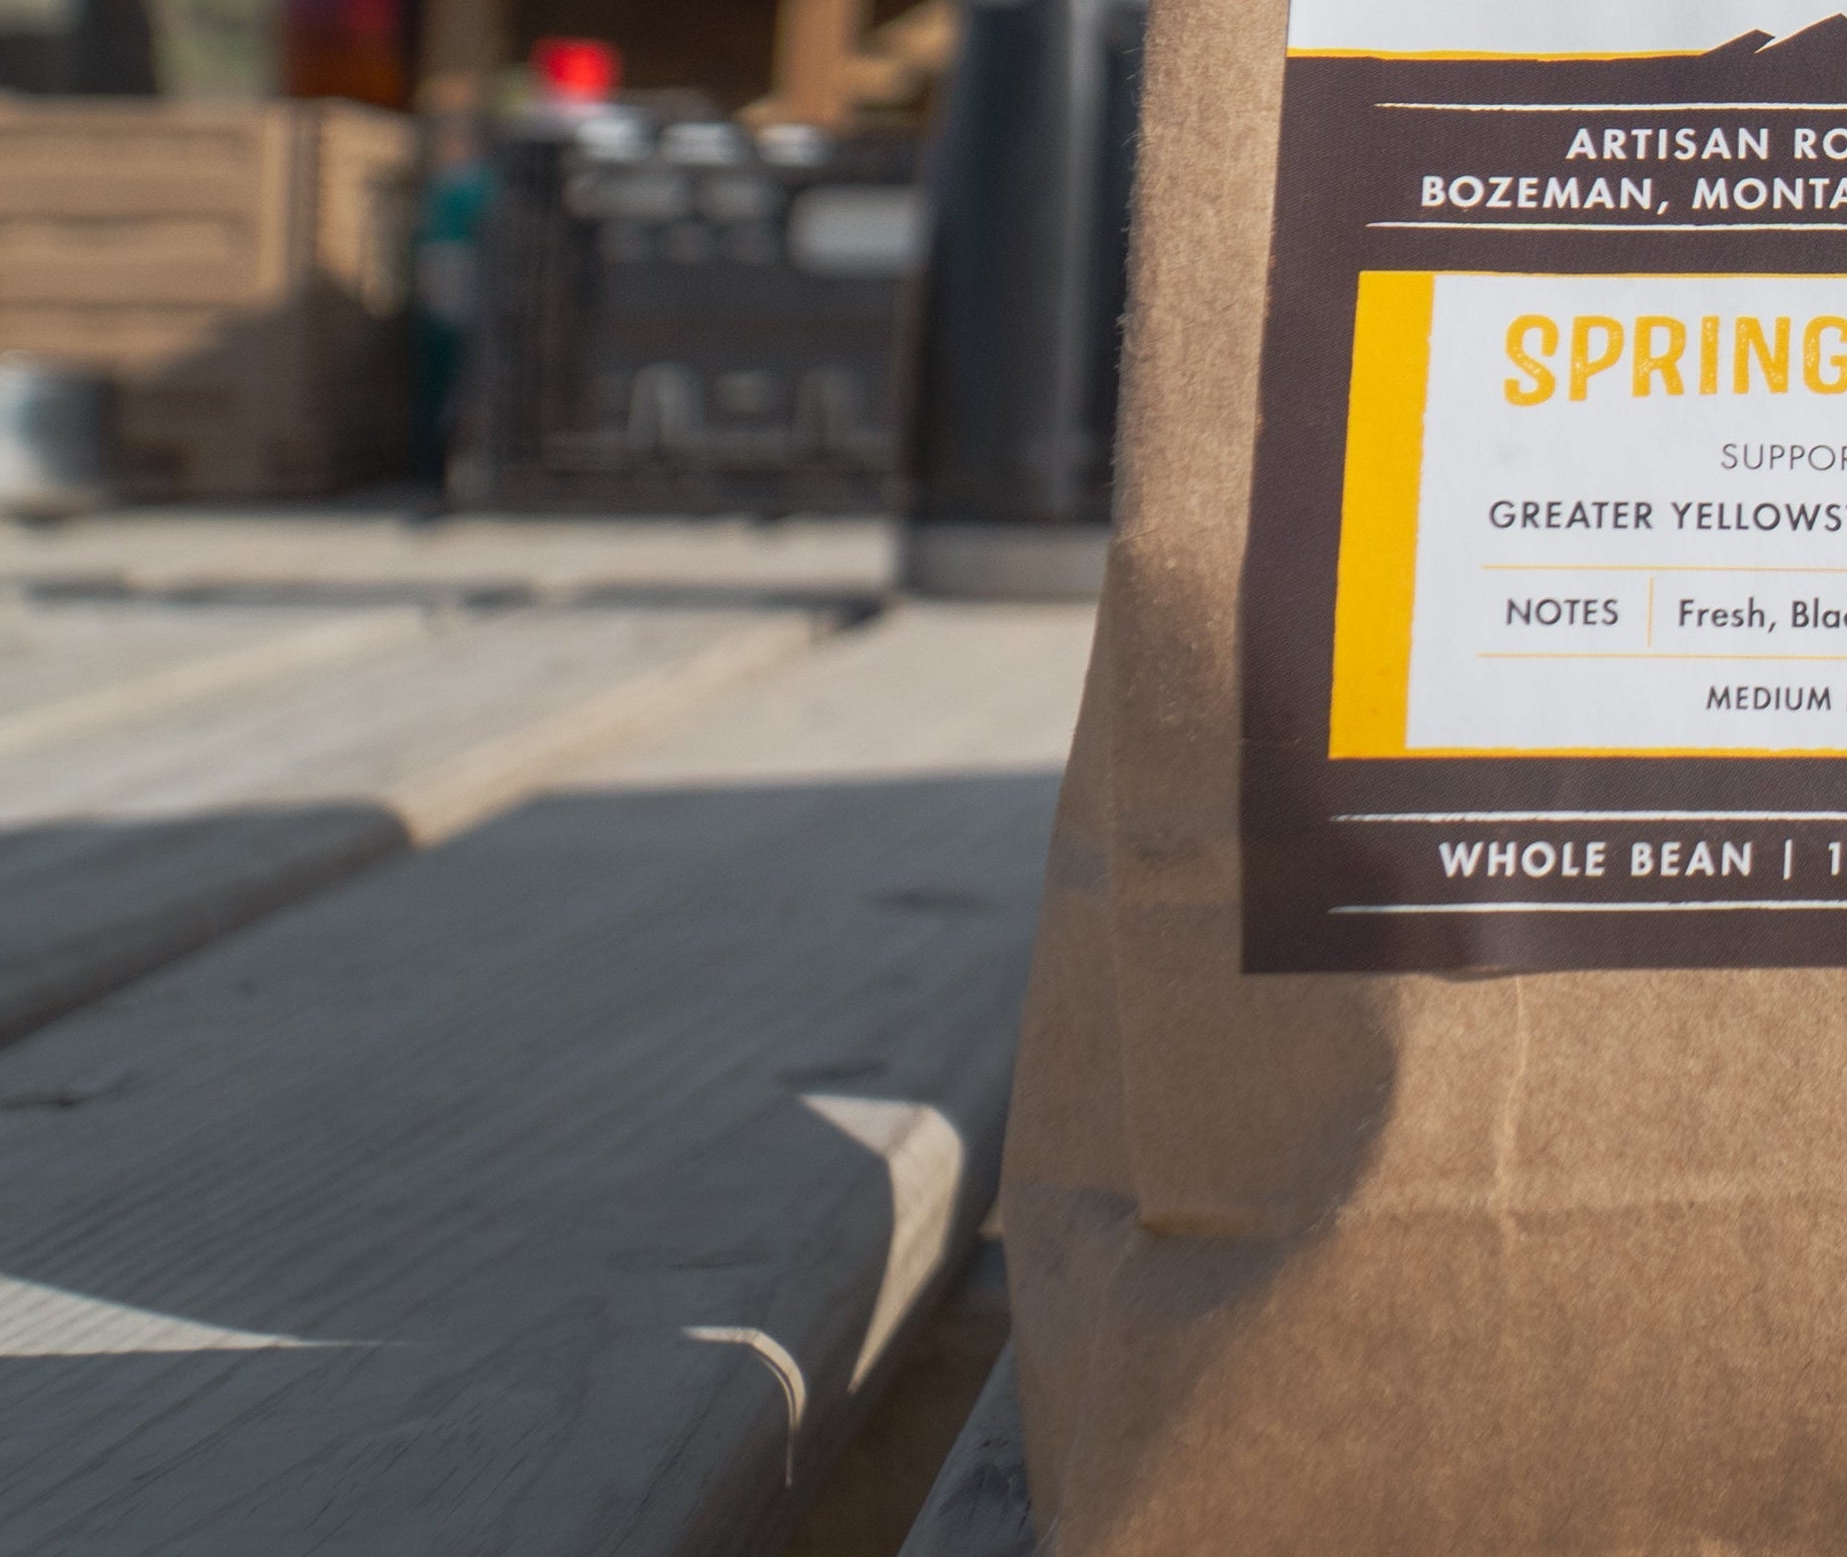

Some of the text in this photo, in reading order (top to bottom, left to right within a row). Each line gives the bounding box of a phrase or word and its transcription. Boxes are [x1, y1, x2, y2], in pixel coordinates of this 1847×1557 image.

[1564, 126, 1771, 162] ARTISAN
[1420, 174, 1670, 216] BOZEMAN,
[1488, 499, 1654, 530] GREATER
[1506, 597, 1620, 627] NOTES
[1678, 595, 1777, 634] Fresh,
[1705, 685, 1833, 712] MEDIUM
[1437, 840, 1607, 879] WHOLE
[1630, 840, 1753, 877] BEAN
